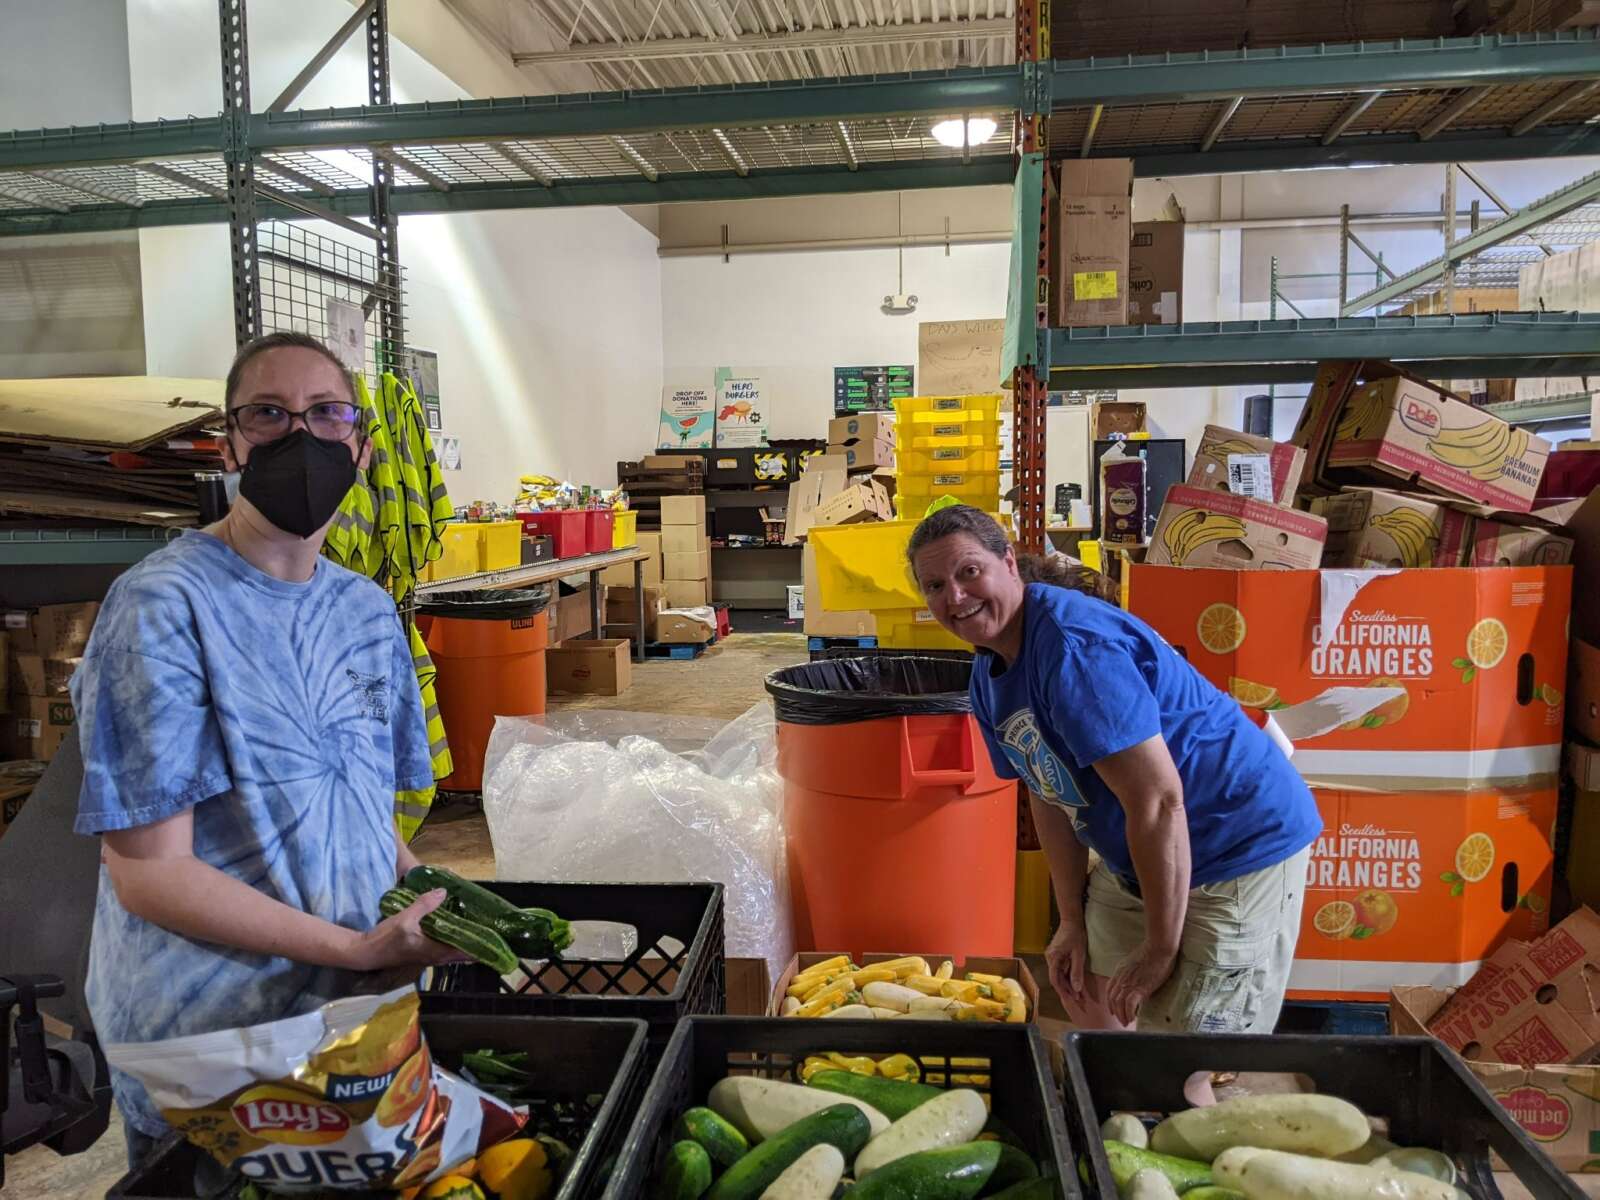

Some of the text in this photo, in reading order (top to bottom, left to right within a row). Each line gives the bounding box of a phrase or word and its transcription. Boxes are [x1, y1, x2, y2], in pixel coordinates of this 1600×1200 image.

[725, 391, 759, 400] BURGERS
[732, 383, 753, 391] HERO
[1406, 402, 1438, 426] Dole
[1500, 464, 1537, 488] BANANAS
[1503, 455, 1540, 476] PREMIUM
[1349, 609, 1398, 622] Seedless
[1311, 647, 1433, 676] ORANGES
[1339, 824, 1386, 836] Seedless
[1312, 837, 1420, 859] ALIFORNIA
[334, 1073, 392, 1097] NEW!
[1541, 1110, 1564, 1125] Del
